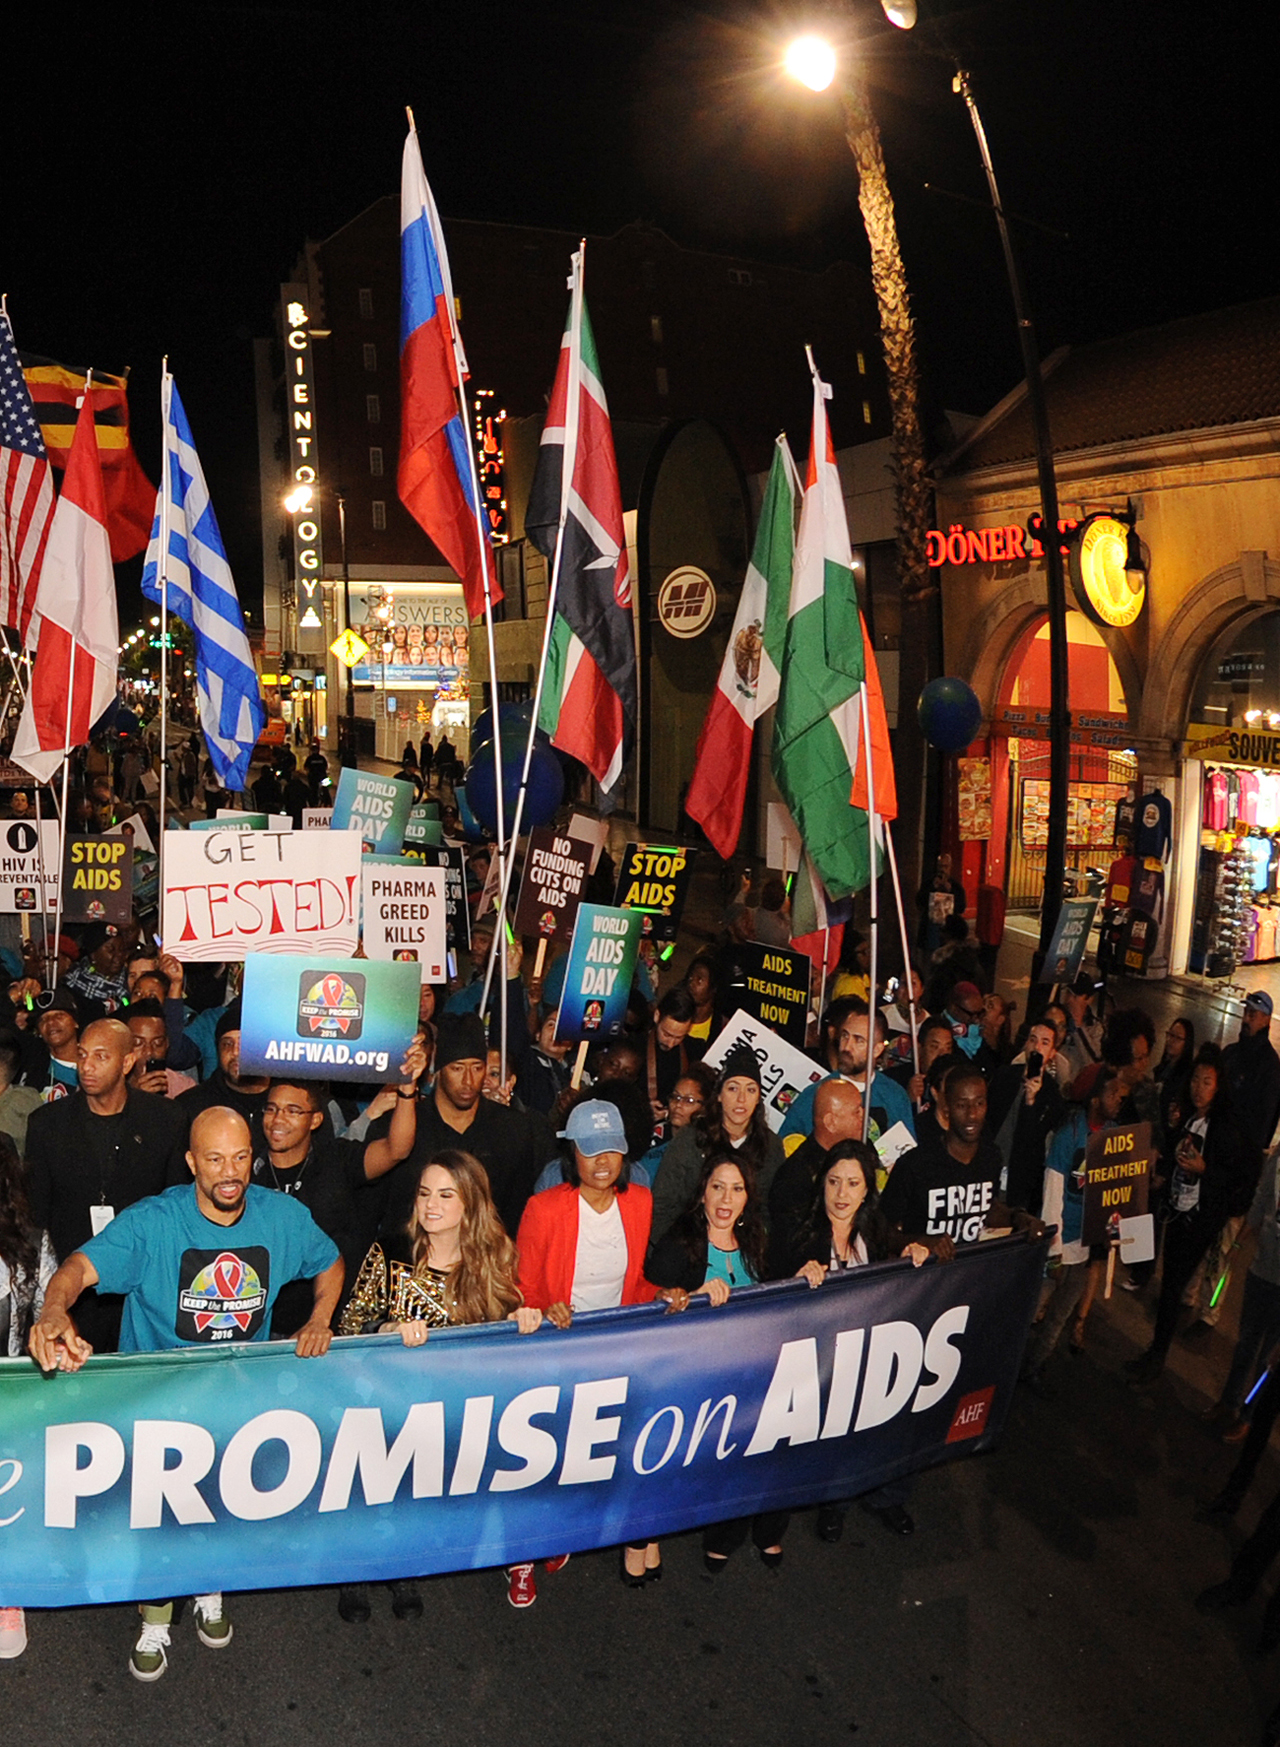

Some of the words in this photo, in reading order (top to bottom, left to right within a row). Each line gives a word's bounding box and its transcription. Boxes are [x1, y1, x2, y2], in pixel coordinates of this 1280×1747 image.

[925, 523, 1026, 567] DÖNER
[364, 605, 466, 624] ASWERS
[1090, 731, 1120, 746] Salad
[356, 778, 397, 798] WORLD
[351, 794, 394, 820] AIDS
[347, 815, 389, 843] DAY
[405, 824, 426, 838] RLD
[71, 842, 126, 864] STOP
[204, 832, 293, 865] GET
[552, 836, 572, 857] NO
[2, 858, 26, 872] HIV
[531, 849, 586, 878] FUNDING
[628, 852, 687, 879] STOP
[72, 869, 122, 891] AIDS
[372, 881, 437, 898] PHARMA
[530, 866, 562, 889] CUTS
[563, 874, 581, 894] ON
[537, 886, 567, 909] AIDS
[624, 881, 677, 907] AIDS
[166, 874, 358, 942] TESTED!
[380, 904, 430, 920] GREED
[384, 926, 426, 943] KILLS
[592, 914, 630, 936] WORLD
[585, 936, 625, 965] AIDS
[762, 953, 793, 976] AIDS
[580, 966, 619, 997] DAY
[747, 976, 807, 1006] TREATMENT
[759, 1003, 791, 1025] NOW
[265, 1039, 390, 1071] AHFWAD.org
[760, 1063, 785, 1098] ILLS
[1103, 1133, 1135, 1156] AIDS
[1087, 1159, 1149, 1185] TREATMENT
[927, 1181, 994, 1220] FREE
[1101, 1185, 1133, 1208] NOW
[926, 1213, 988, 1244] HUG
[183, 1297, 208, 1310] KEEP
[208, 1300, 222, 1312] the
[222, 1296, 262, 1311] PROMISE
[210, 1329, 233, 1340] 2016
[44, 1376, 632, 1531] PROMISE
[632, 1391, 738, 1473] on
[741, 1304, 970, 1458] AIDS
[953, 1401, 986, 1427] AHF
